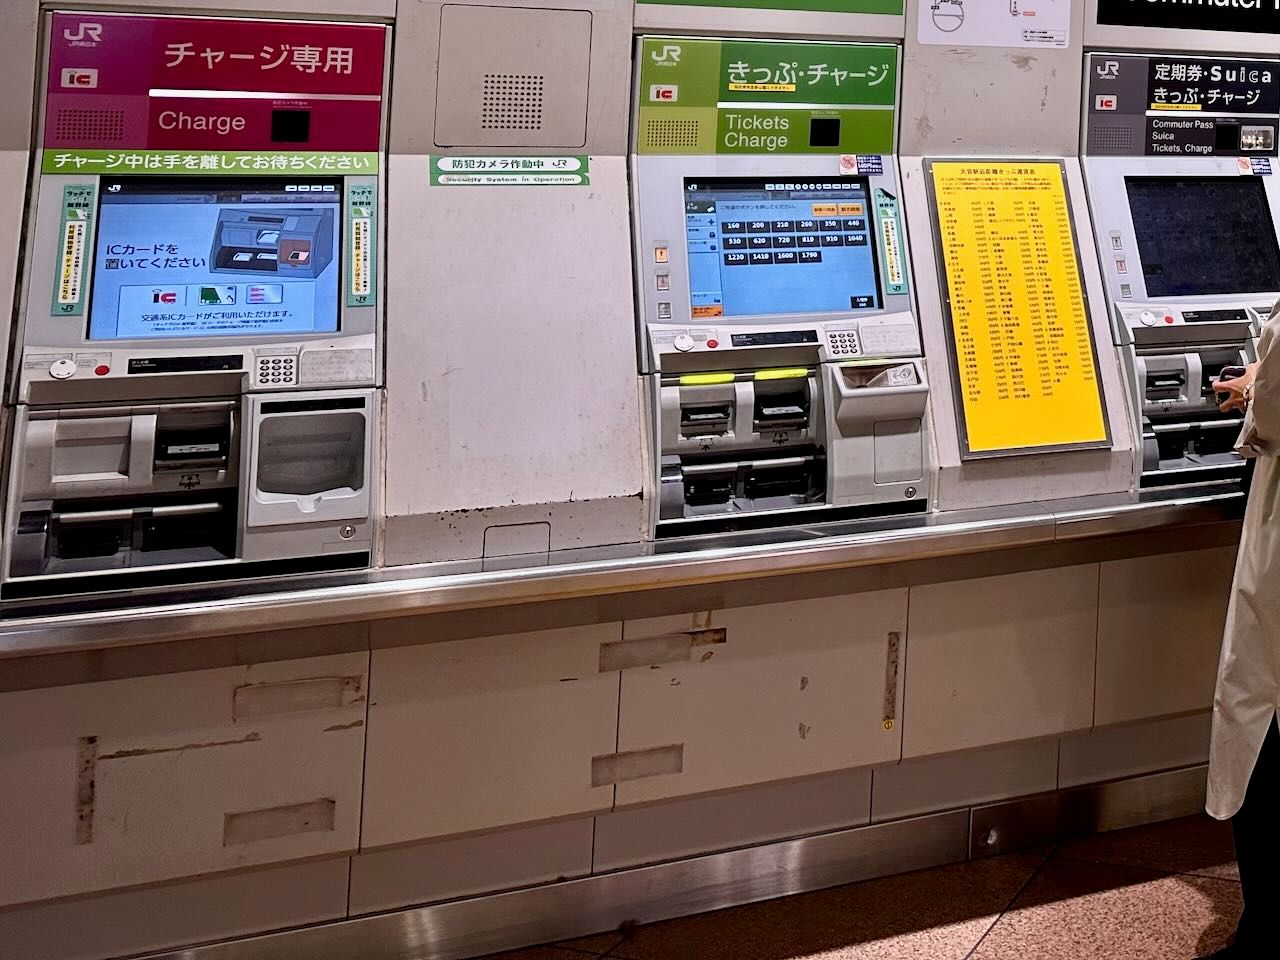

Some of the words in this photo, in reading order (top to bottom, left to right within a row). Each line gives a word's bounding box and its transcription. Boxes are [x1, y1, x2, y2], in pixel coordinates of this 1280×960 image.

[64, 23, 102, 42] JR
[164, 42, 354, 75] チャージ専用
[651, 45, 681, 62] JR
[727, 61, 889, 87] きっぷ・チャージ
[1097, 61, 1120, 76] JR
[1154, 87, 1260, 105] きっぷ・チャージ
[158, 111, 246, 134] Charge
[725, 114, 789, 131] Tickets
[1152, 120, 1194, 129] Commuter
[1195, 121, 1214, 129] Pass
[724, 132, 788, 151] Charge
[1152, 132, 1175, 140] Suica
[1152, 144, 1182, 153] Tickets,
[1185, 144, 1213, 154] Charge
[54, 154, 369, 171] チャージ中は手を離してお待ちください
[452, 159, 545, 169] 防犯カメラ作動中
[552, 160, 567, 168] JR
[106, 243, 179, 255] ICカードを
[105, 256, 206, 270] 置いてください
